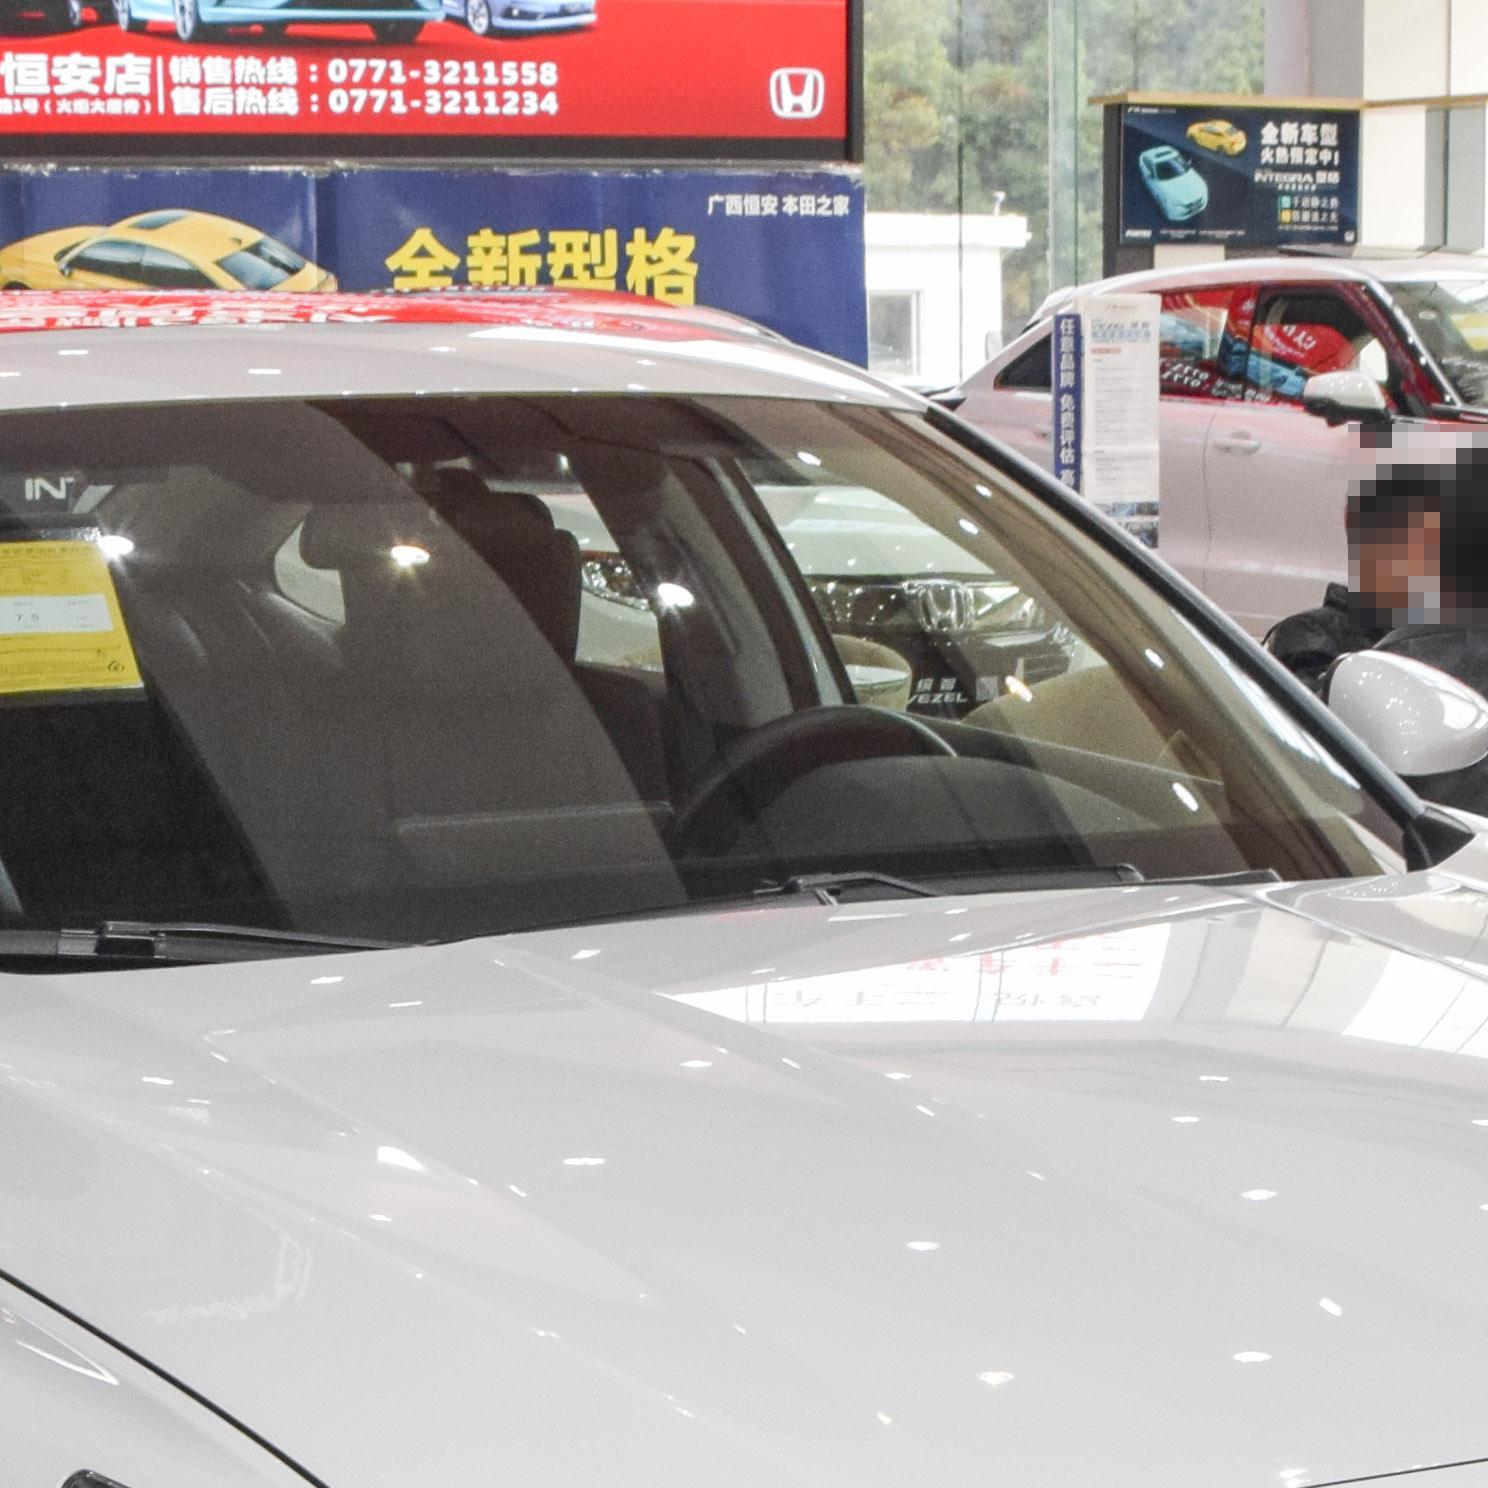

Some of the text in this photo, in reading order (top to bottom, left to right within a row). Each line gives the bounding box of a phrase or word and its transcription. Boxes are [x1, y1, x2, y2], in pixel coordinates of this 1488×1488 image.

[708, 195, 850, 217] 广西恒安 本田之家
[384, 226, 699, 306] 全新型格
